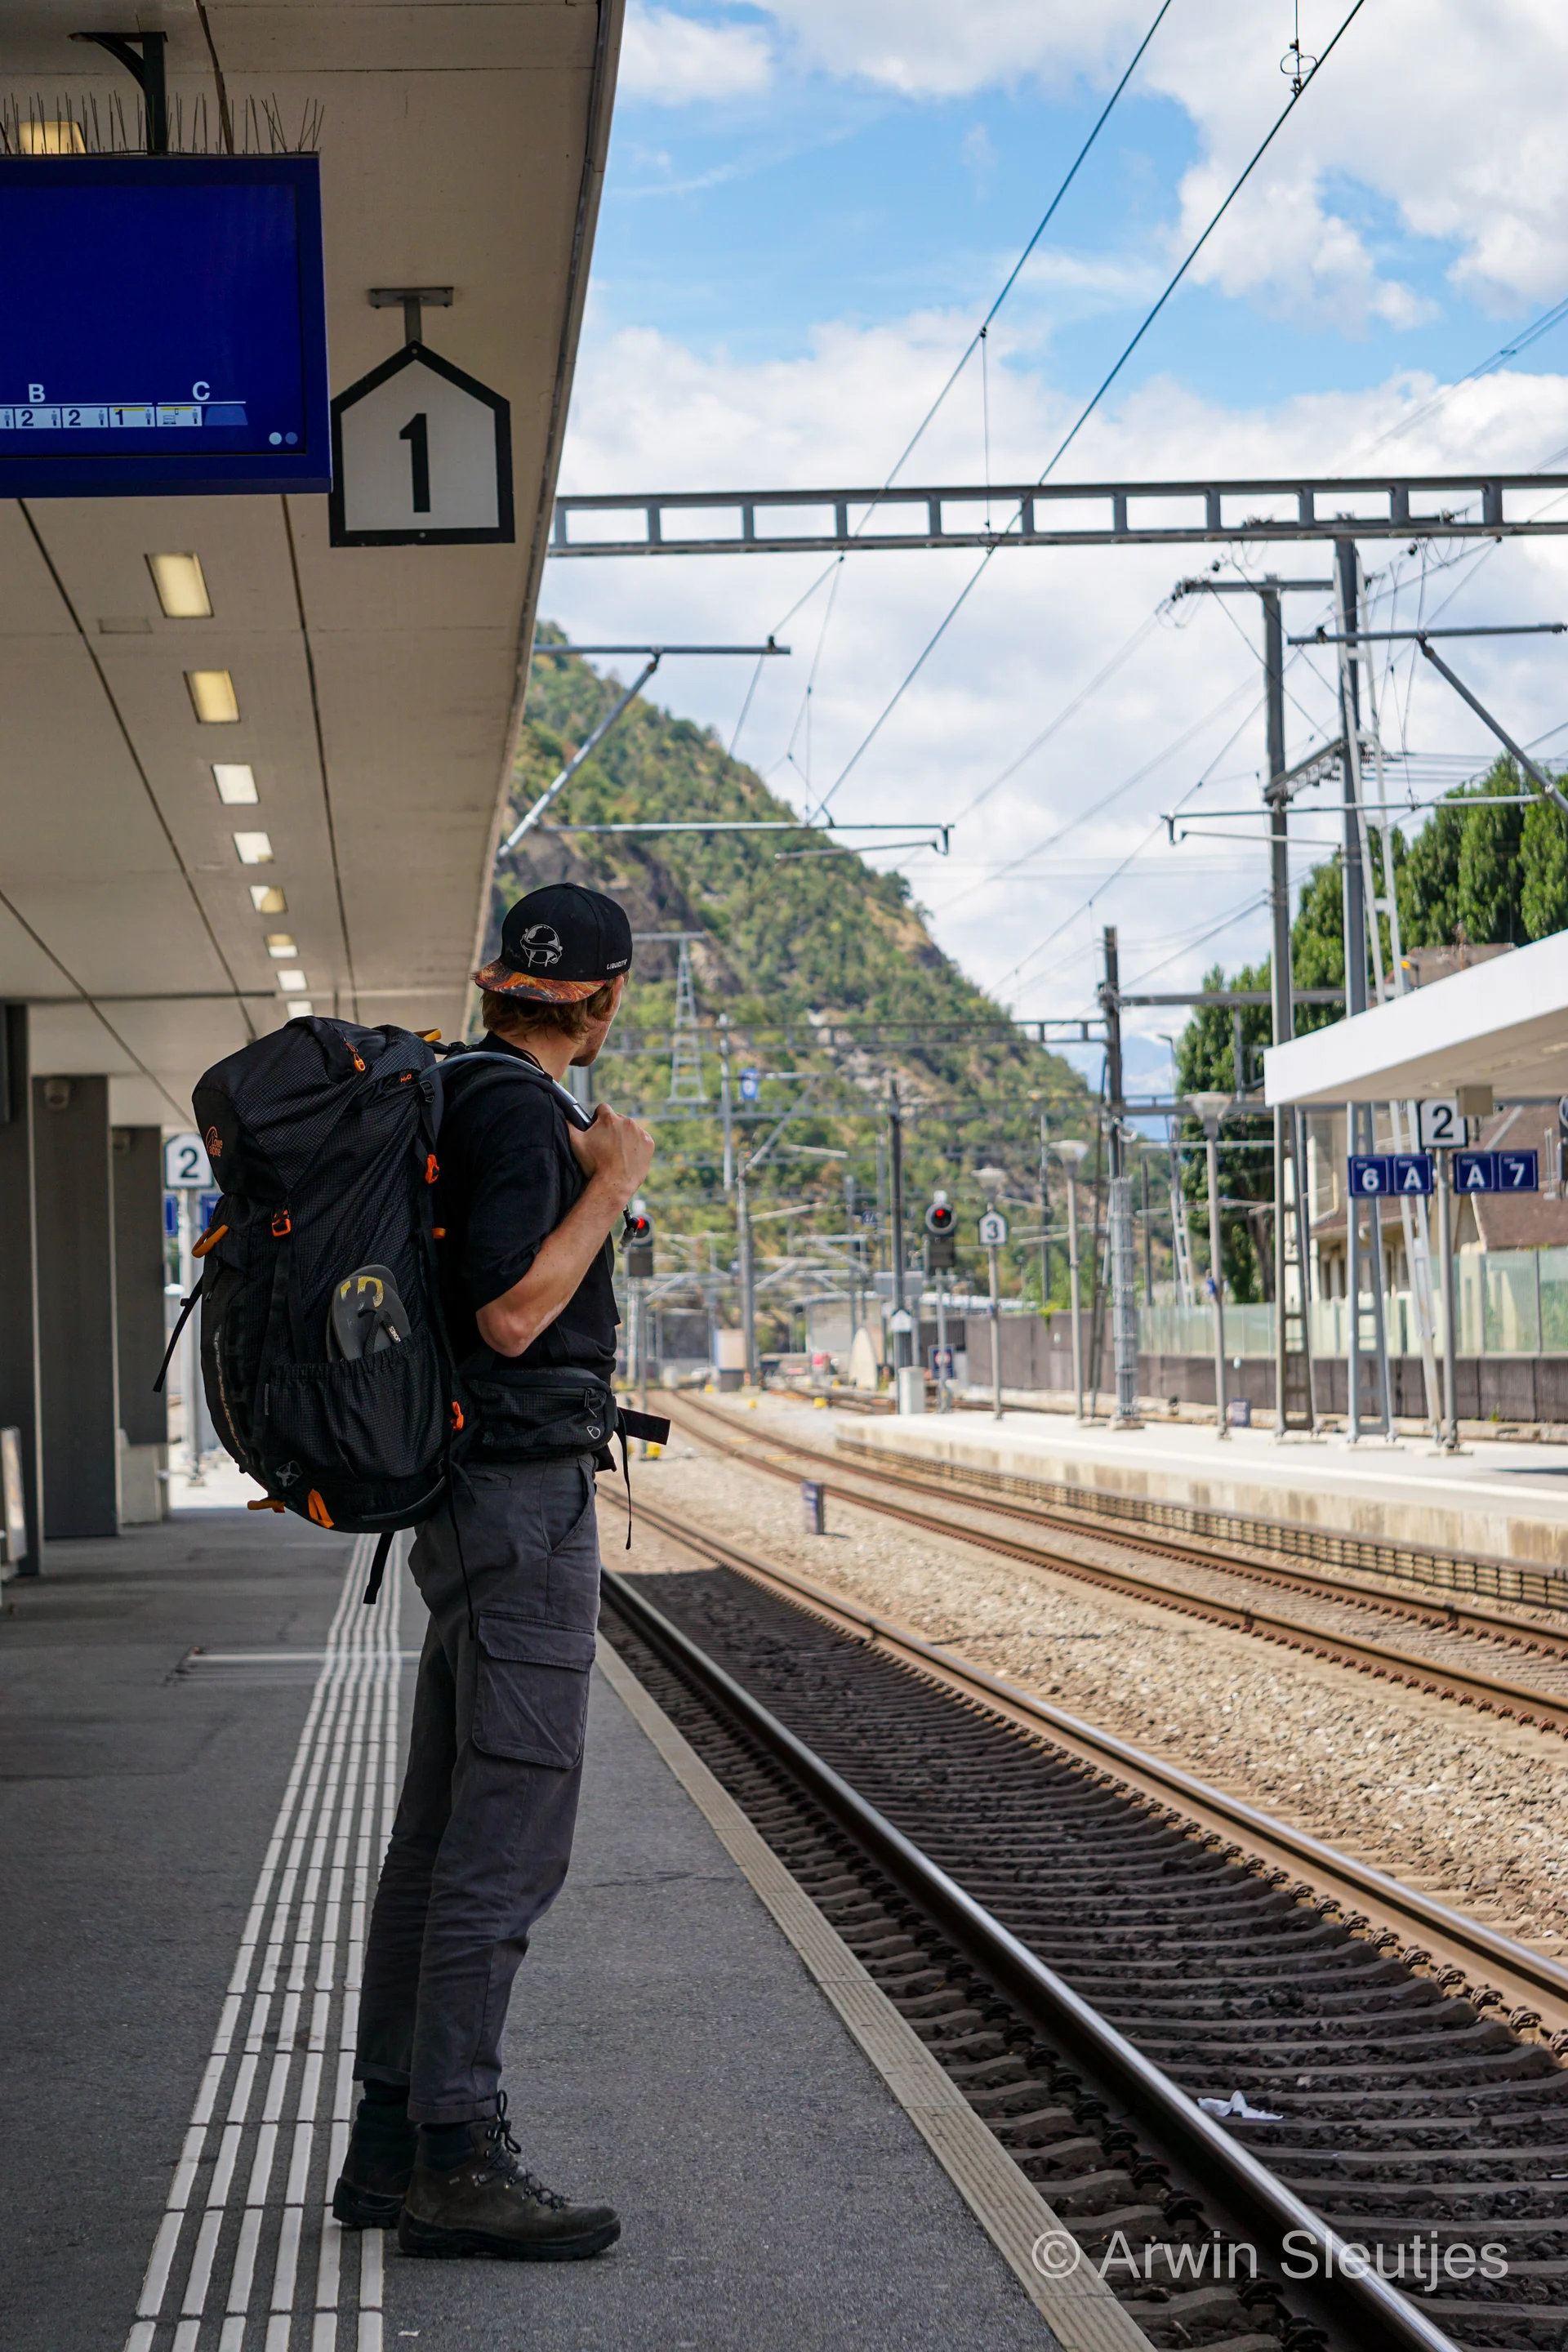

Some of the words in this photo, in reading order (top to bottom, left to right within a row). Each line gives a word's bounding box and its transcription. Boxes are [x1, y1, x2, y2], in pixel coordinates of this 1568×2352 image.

[28, 383, 46, 403] B
[192, 381, 211, 401] C
[21, 410, 33, 426] 2
[68, 409, 81, 426] 2
[114, 409, 123, 425] 1
[399, 412, 430, 513] 1
[1432, 1104, 1454, 1139] 2
[179, 1147, 199, 1178] 2
[1361, 1168, 1379, 1192] 6
[1403, 1166, 1423, 1190] A
[1466, 1164, 1486, 1187] A
[1509, 1163, 1526, 1187] 7
[987, 1220, 999, 1240] 3
